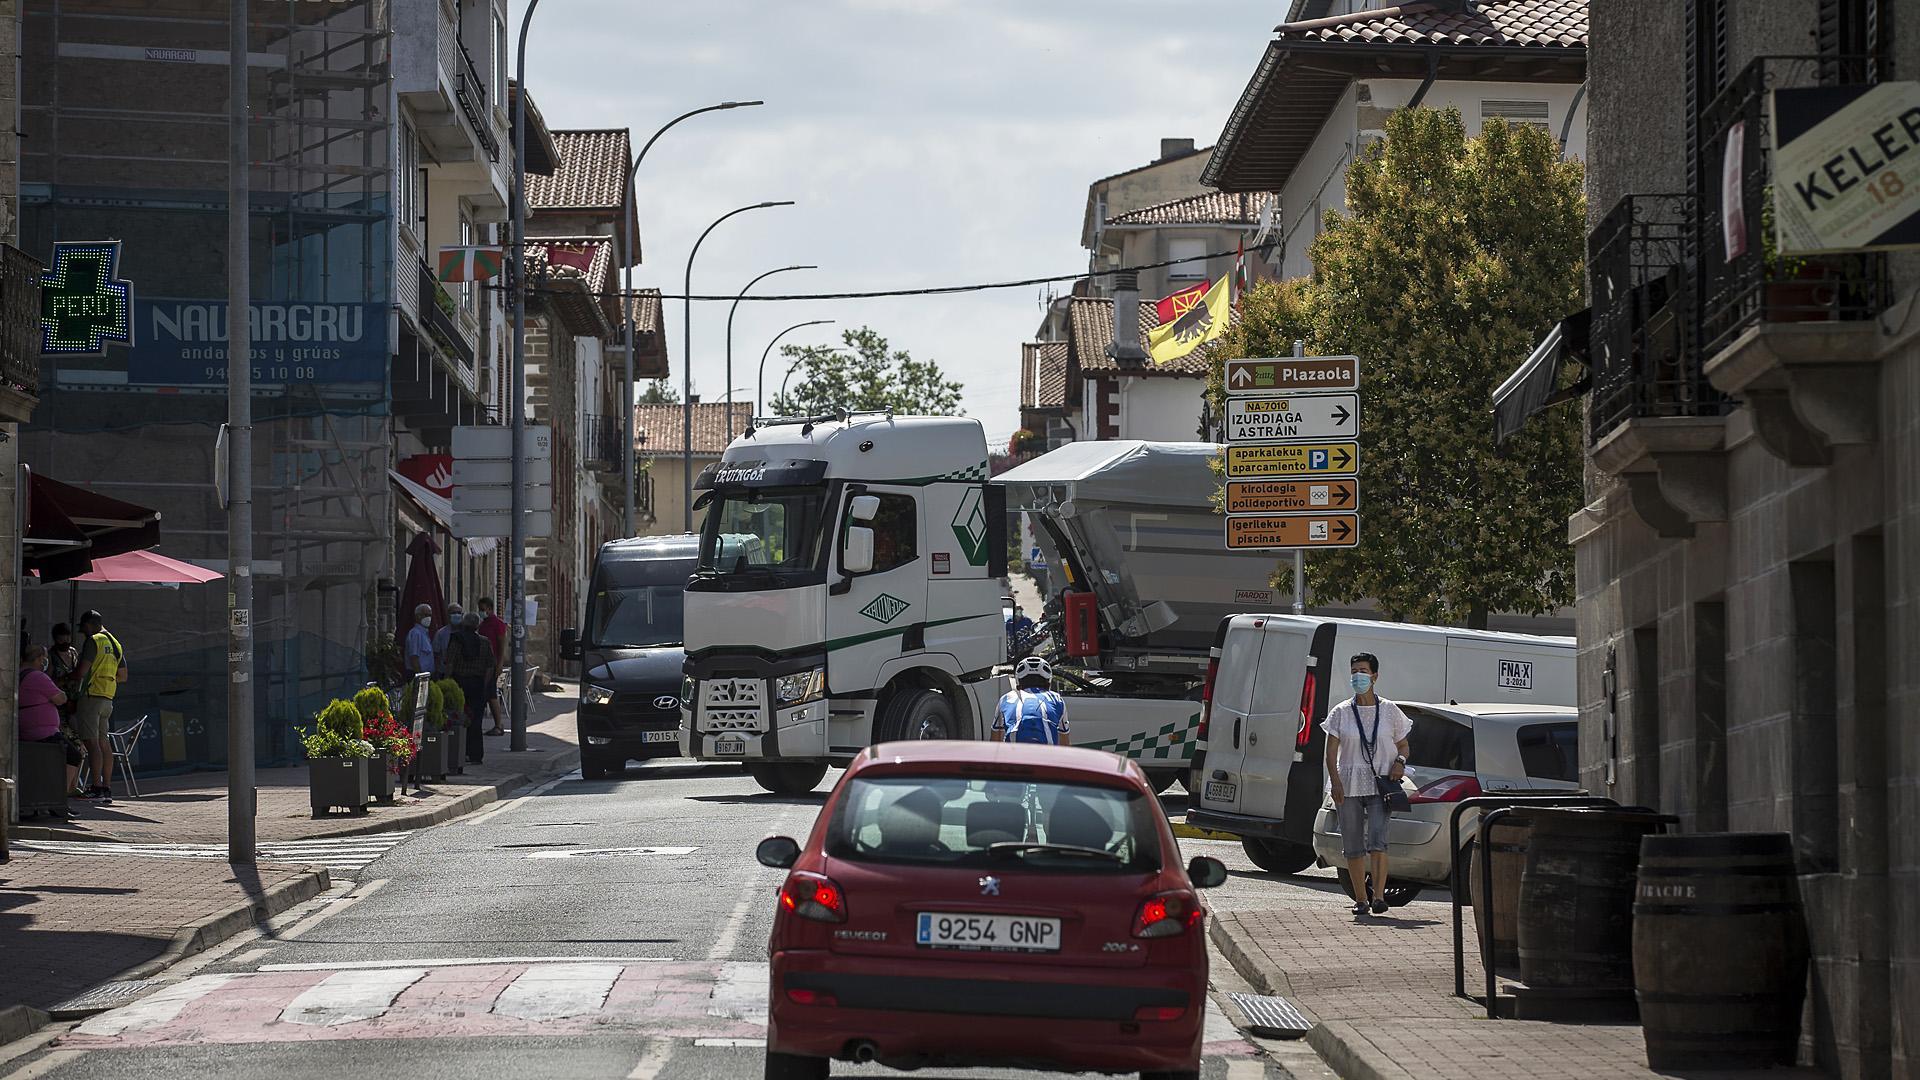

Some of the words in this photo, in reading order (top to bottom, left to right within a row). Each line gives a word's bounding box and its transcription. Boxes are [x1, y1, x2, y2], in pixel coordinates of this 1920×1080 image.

[145, 49, 195, 61] NAVARGRU
[1866, 171, 1904, 204] 18
[53, 295, 109, 317] PERD
[181, 346, 267, 360] andaos
[275, 348, 284, 362] y
[292, 346, 341, 362] grúas
[206, 367, 229, 379] 94
[270, 367, 288, 379] 10
[295, 367, 314, 379] 08
[1282, 367, 1351, 381] Plazaola
[1247, 401, 1288, 411] NA-7010
[1232, 412, 1303, 425] IZURDIAGA
[1238, 423, 1298, 437] ASTRÁIN
[1235, 448, 1303, 459] aparkalekua
[1232, 461, 1306, 473] aparcamiento
[1241, 484, 1296, 494] kiroldegia
[1232, 498, 1305, 509] polideportivo
[1237, 534, 1281, 545] piscinas
[1237, 591, 1269, 599] HARDOX
[648, 732, 671, 741] 7015
[834, 930, 887, 941] PEUGEOT
[938, 918, 997, 942] 9254
[1010, 921, 1054, 944] GNP
